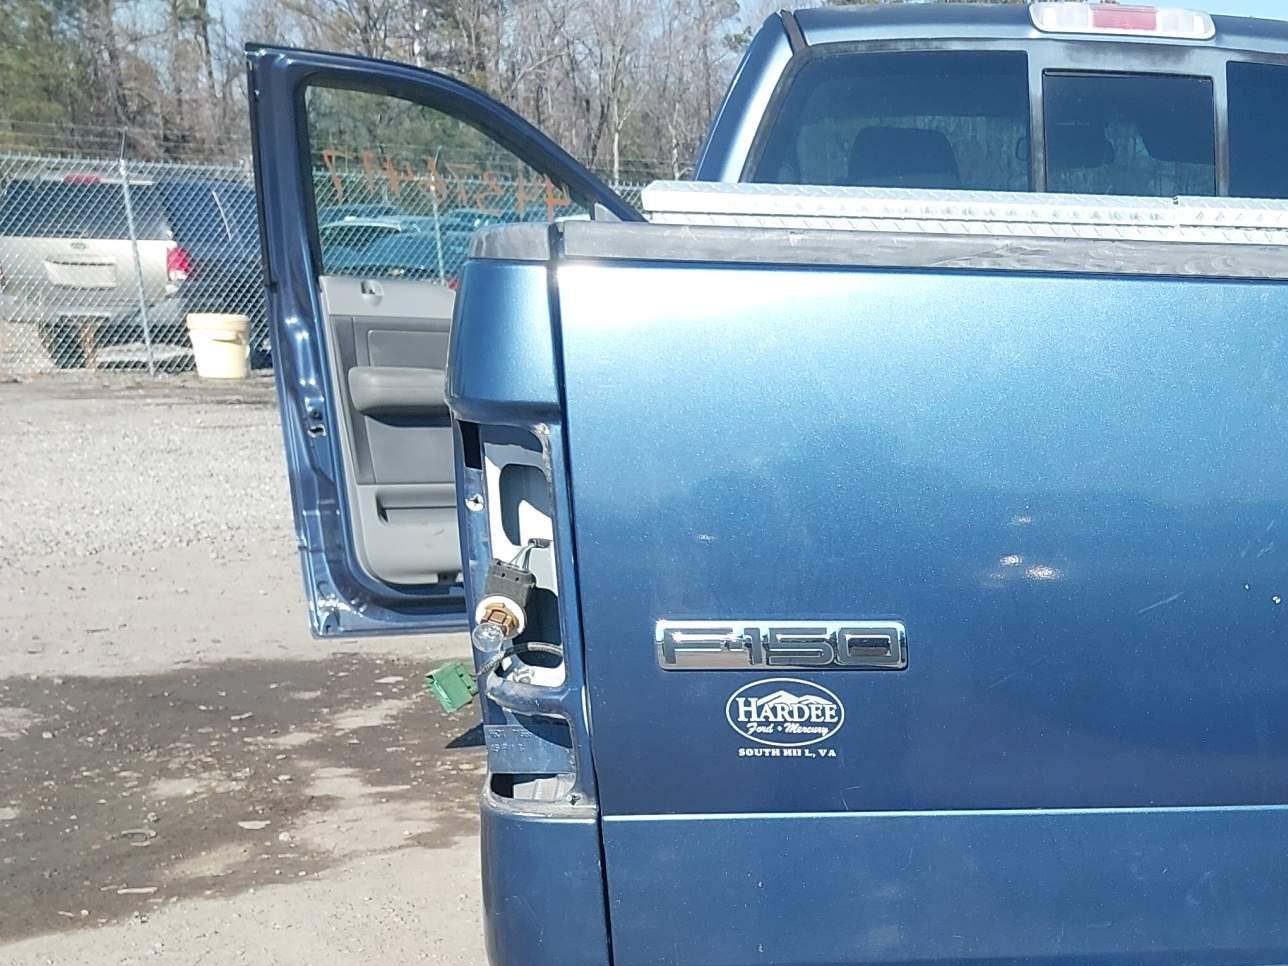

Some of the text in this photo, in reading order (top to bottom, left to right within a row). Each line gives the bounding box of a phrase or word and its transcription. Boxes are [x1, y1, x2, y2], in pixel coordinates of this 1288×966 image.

[736, 697, 838, 722] HARDEE
[746, 722, 828, 737] Ford Mercury
[738, 748, 780, 757] SOUTH
[817, 749, 836, 757] VA
